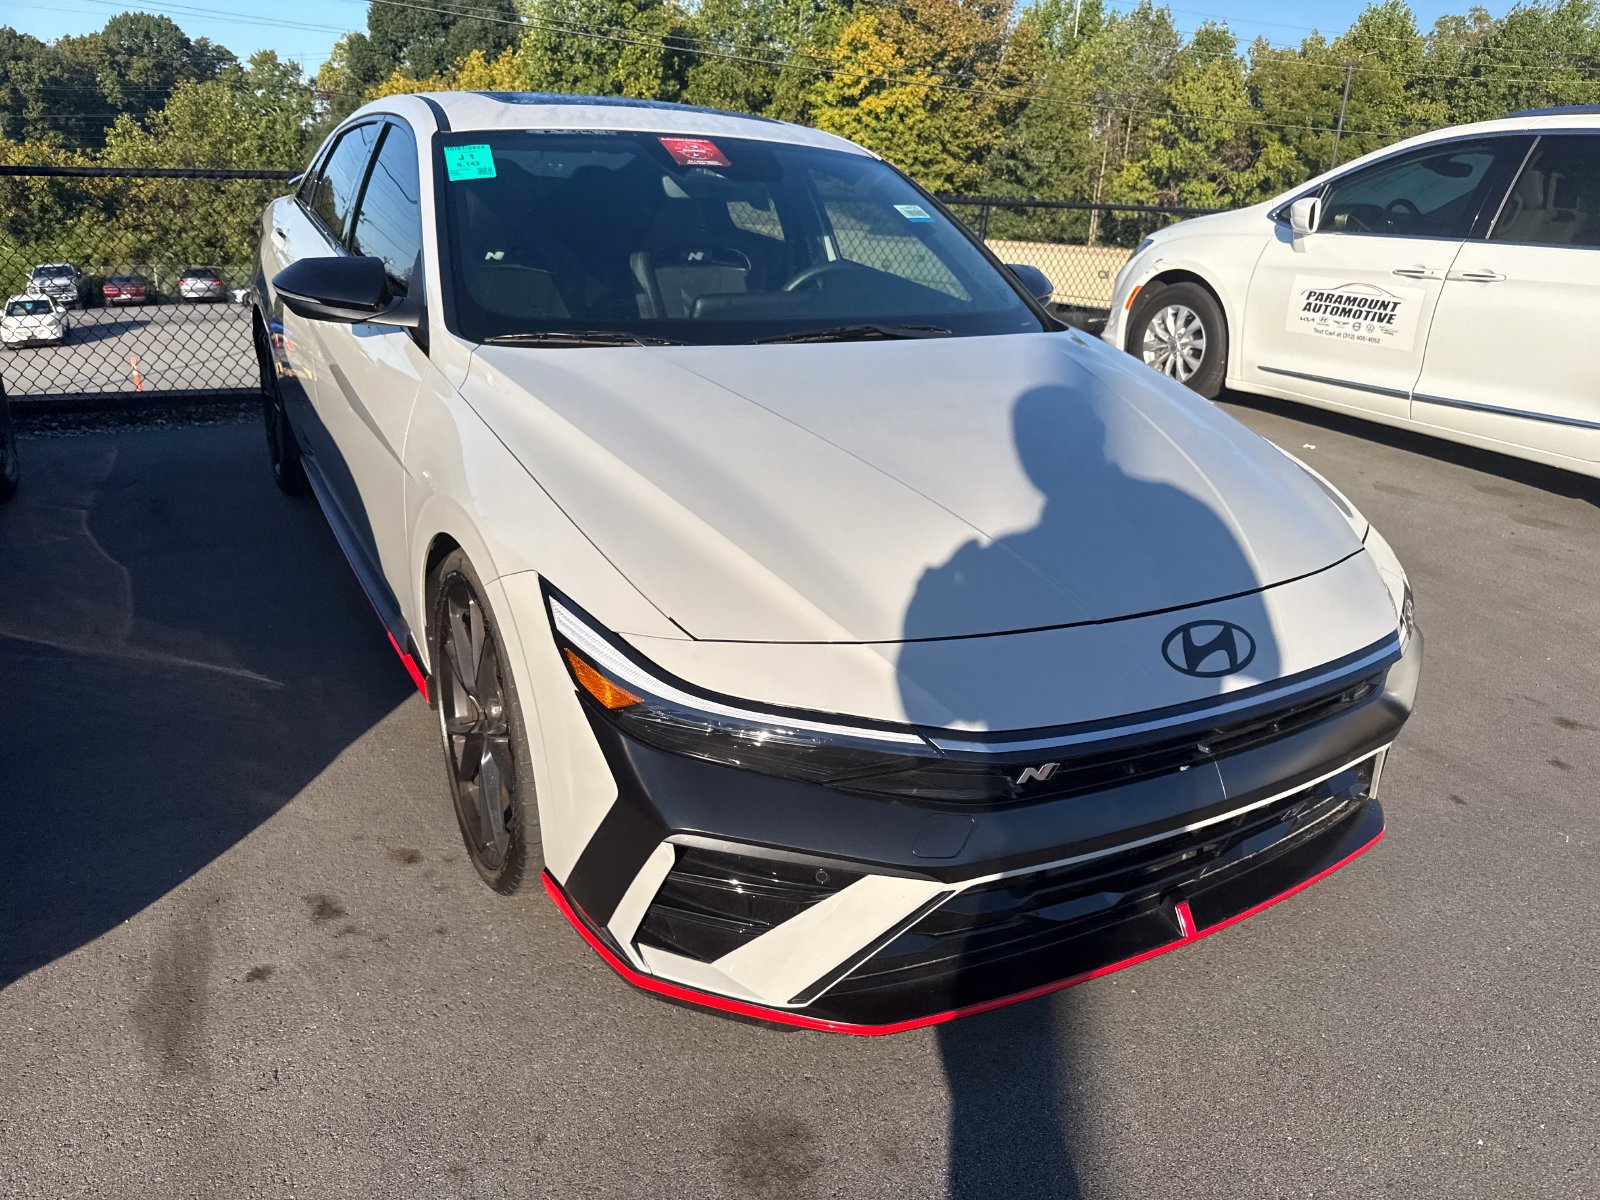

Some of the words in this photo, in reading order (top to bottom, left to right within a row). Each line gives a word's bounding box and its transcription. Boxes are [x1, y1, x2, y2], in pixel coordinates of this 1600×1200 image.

[1305, 291, 1401, 312] PARAMOUNT
[1302, 302, 1397, 324] AUTOMOTIVE
[1016, 762, 1061, 785] N
